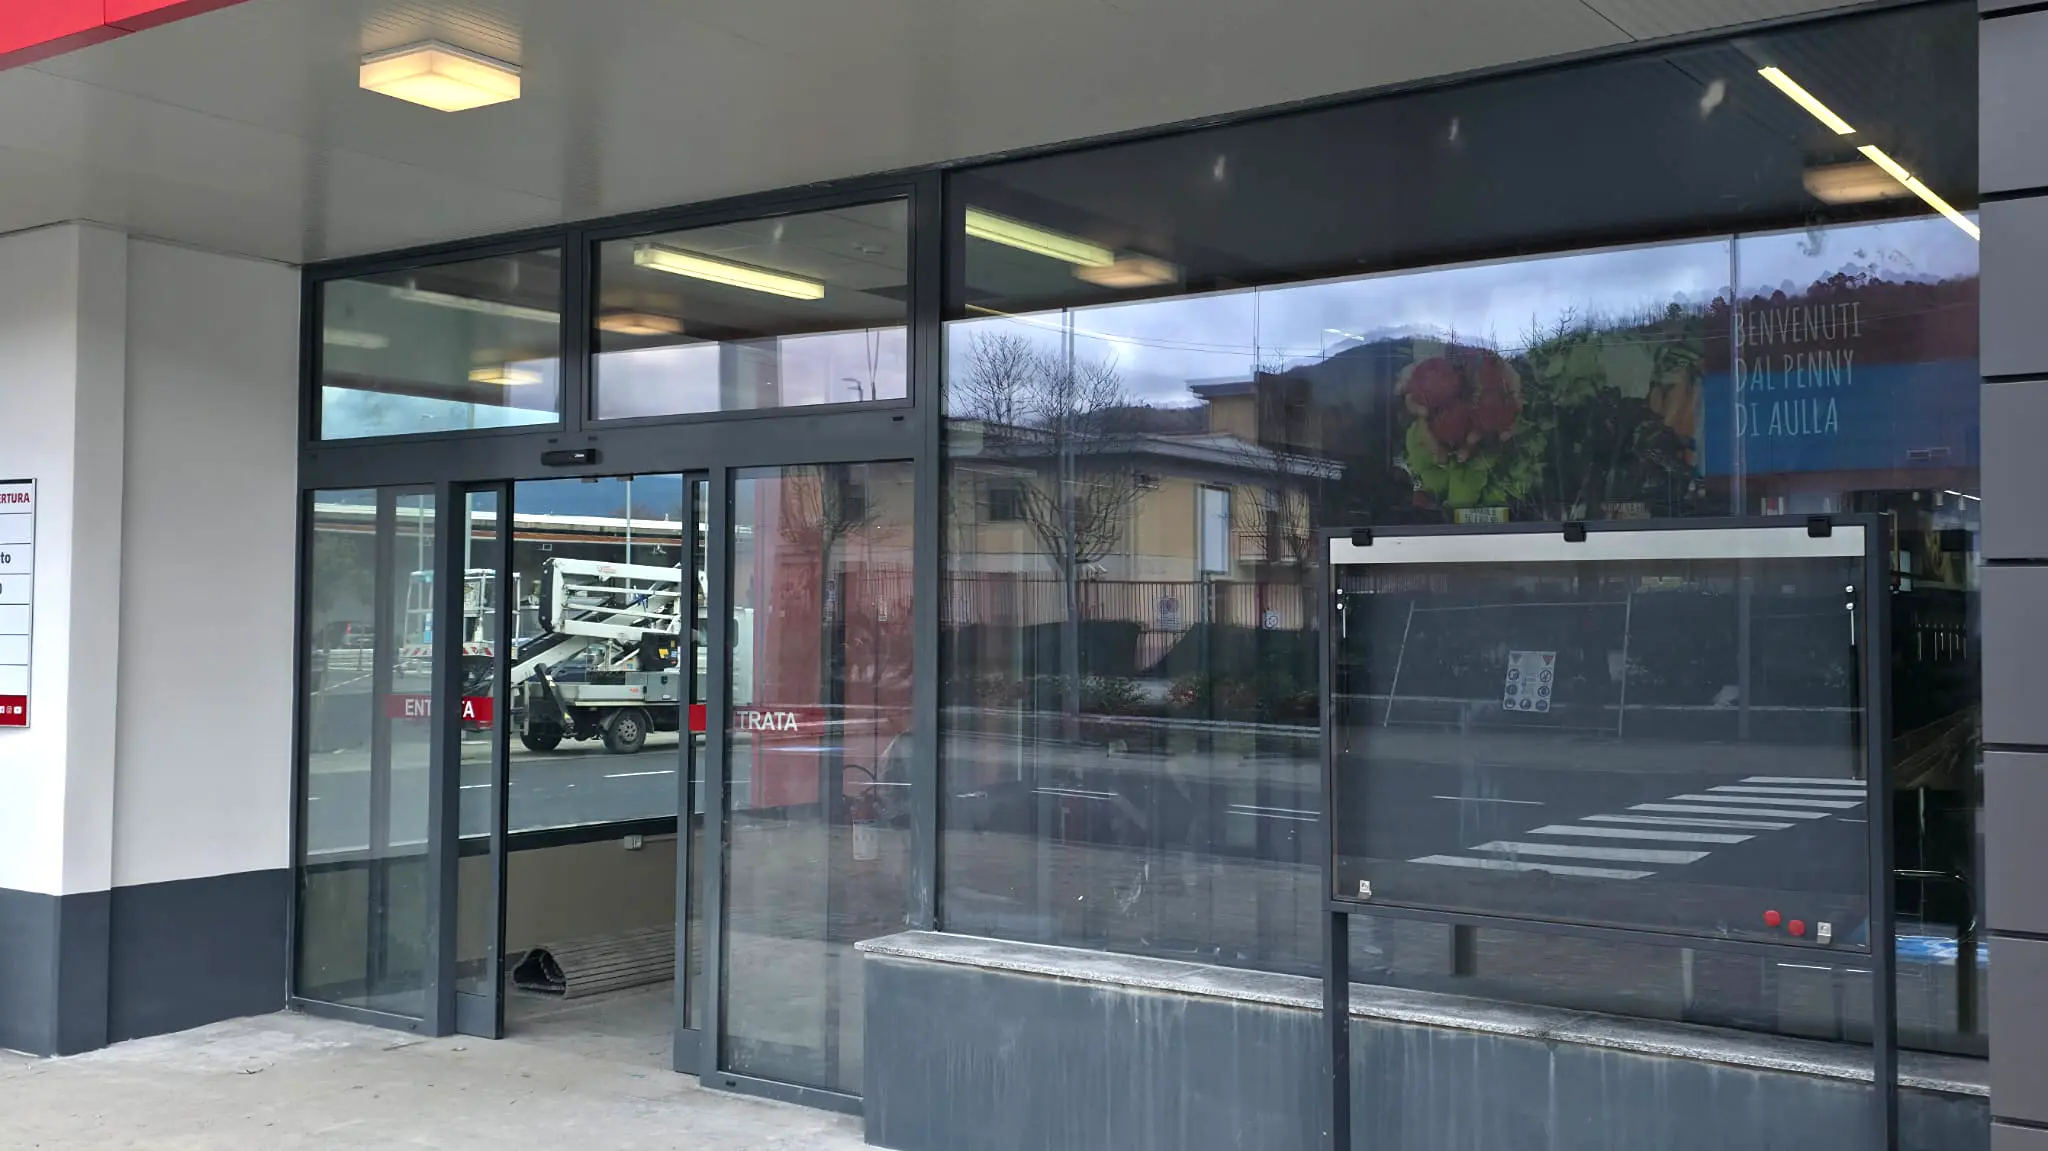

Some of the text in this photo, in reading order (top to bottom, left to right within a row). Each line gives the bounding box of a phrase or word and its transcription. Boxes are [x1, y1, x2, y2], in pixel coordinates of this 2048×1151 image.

[1734, 301, 1862, 348] BENVENUTI
[1734, 349, 1854, 393] DAL PENNY
[1734, 397, 1839, 438] DI AULLA
[736, 710, 799, 732] TRATA
